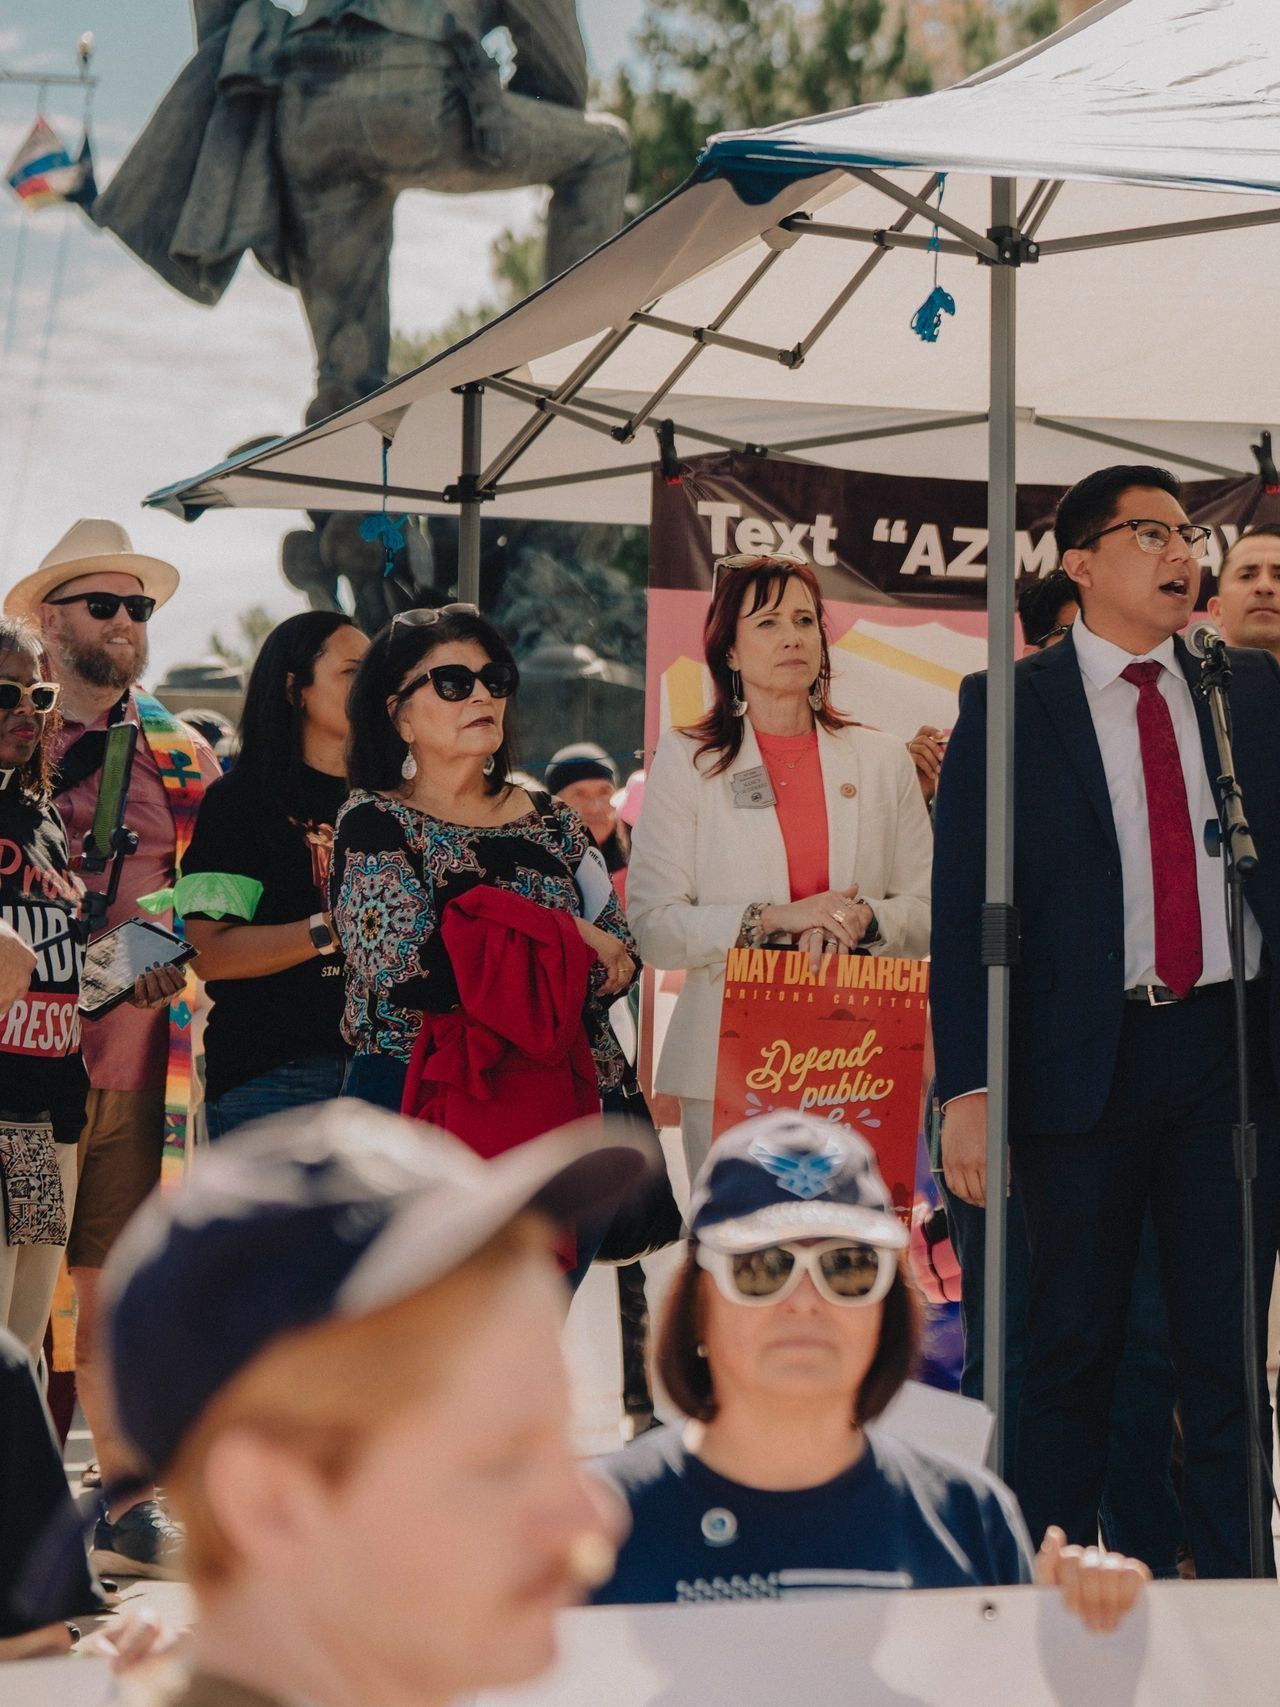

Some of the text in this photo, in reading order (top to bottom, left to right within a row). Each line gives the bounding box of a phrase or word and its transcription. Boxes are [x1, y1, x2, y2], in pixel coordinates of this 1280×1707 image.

[697, 500, 838, 567] Text
[726, 948, 929, 993] MAY DAY MARCH
[725, 988, 926, 1009] ARIZONA CAPITOL
[745, 1029, 883, 1093] Defend
[799, 1071, 895, 1112] public
